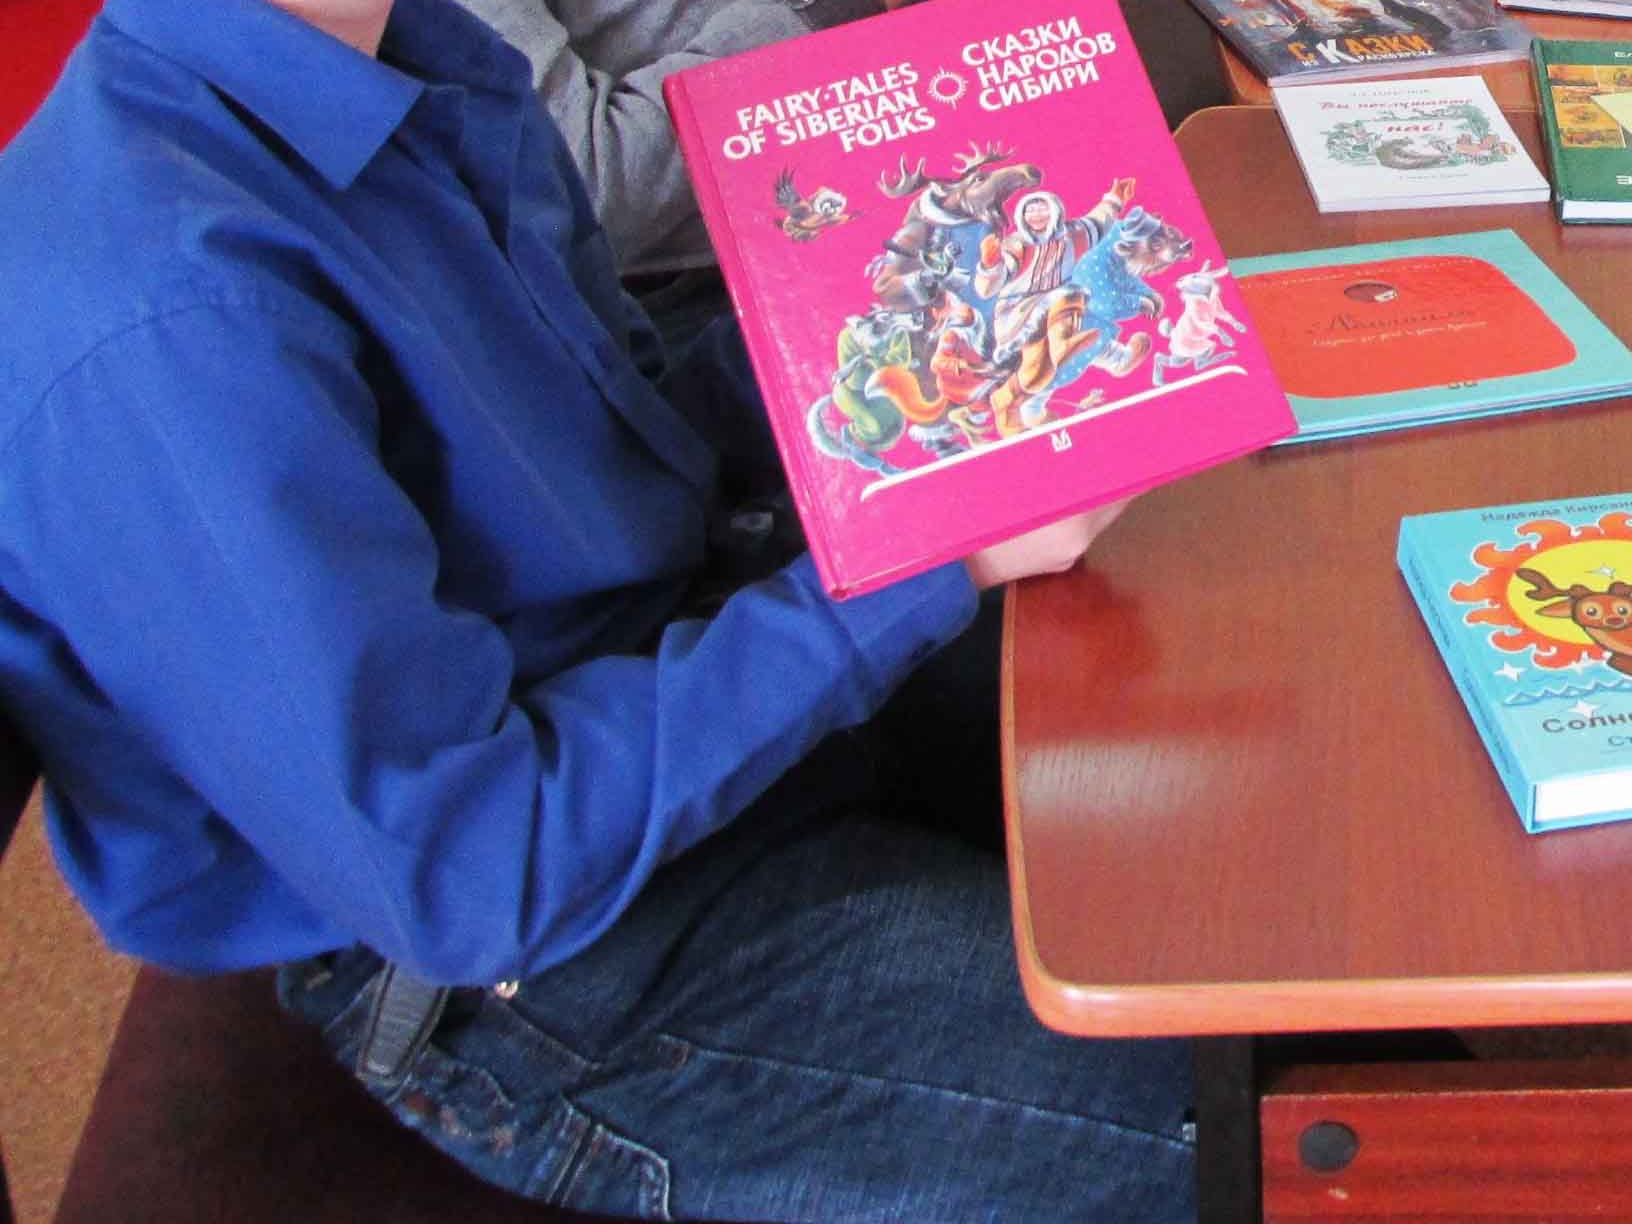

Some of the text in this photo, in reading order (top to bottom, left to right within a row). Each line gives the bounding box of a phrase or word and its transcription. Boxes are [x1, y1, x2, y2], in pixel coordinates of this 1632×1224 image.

[962, 16, 1083, 66] СКАЗКИ
[977, 32, 1117, 89] НАРОДОВ
[1287, 33, 1434, 64] СКАЗКИ
[979, 60, 1100, 111] СИБИРИ
[722, 87, 920, 160] OF SIBERIAN
[840, 107, 936, 153] FOLKS
[1480, 507, 1561, 522] Надежда
